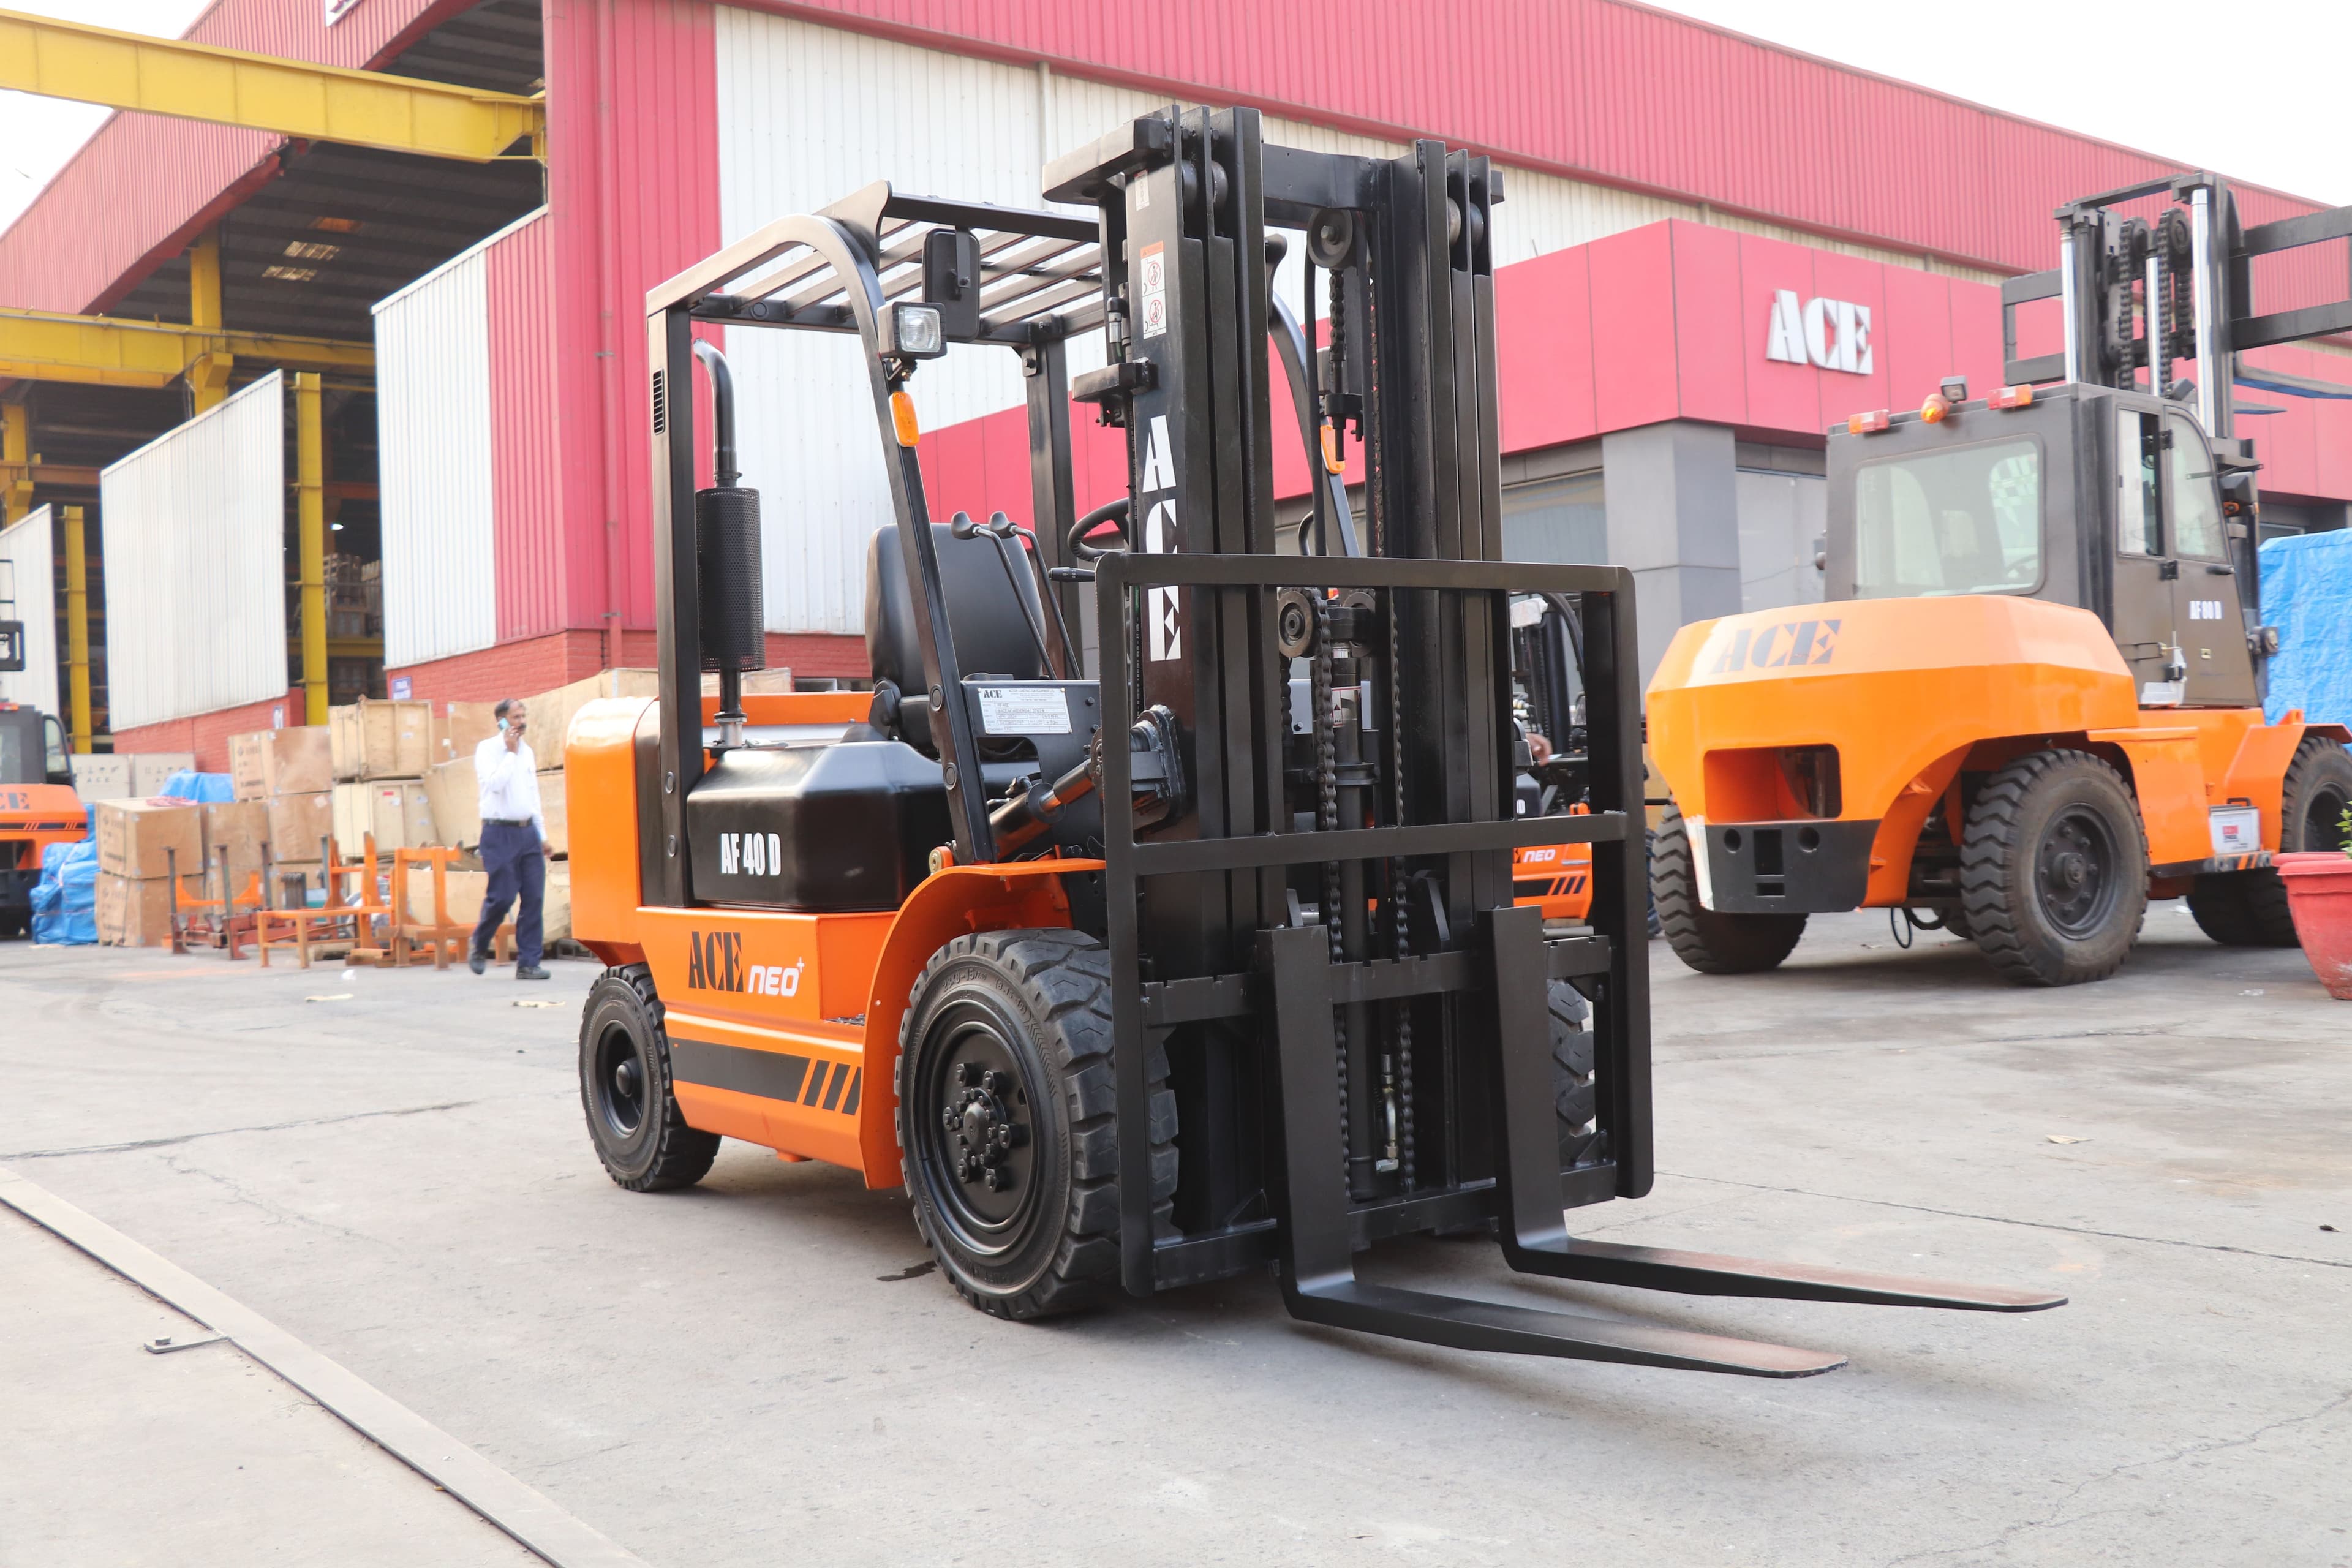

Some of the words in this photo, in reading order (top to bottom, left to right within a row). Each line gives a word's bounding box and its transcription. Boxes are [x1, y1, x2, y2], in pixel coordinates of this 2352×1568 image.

[1766, 289, 1874, 375] ACE
[1142, 415, 1182, 662] ACE
[1711, 619, 1842, 674] ACE
[984, 689, 1003, 699] ACE
[721, 832, 740, 874] AF
[743, 832, 766, 875] 40
[768, 833, 782, 875] D
[688, 930, 744, 992] ACE
